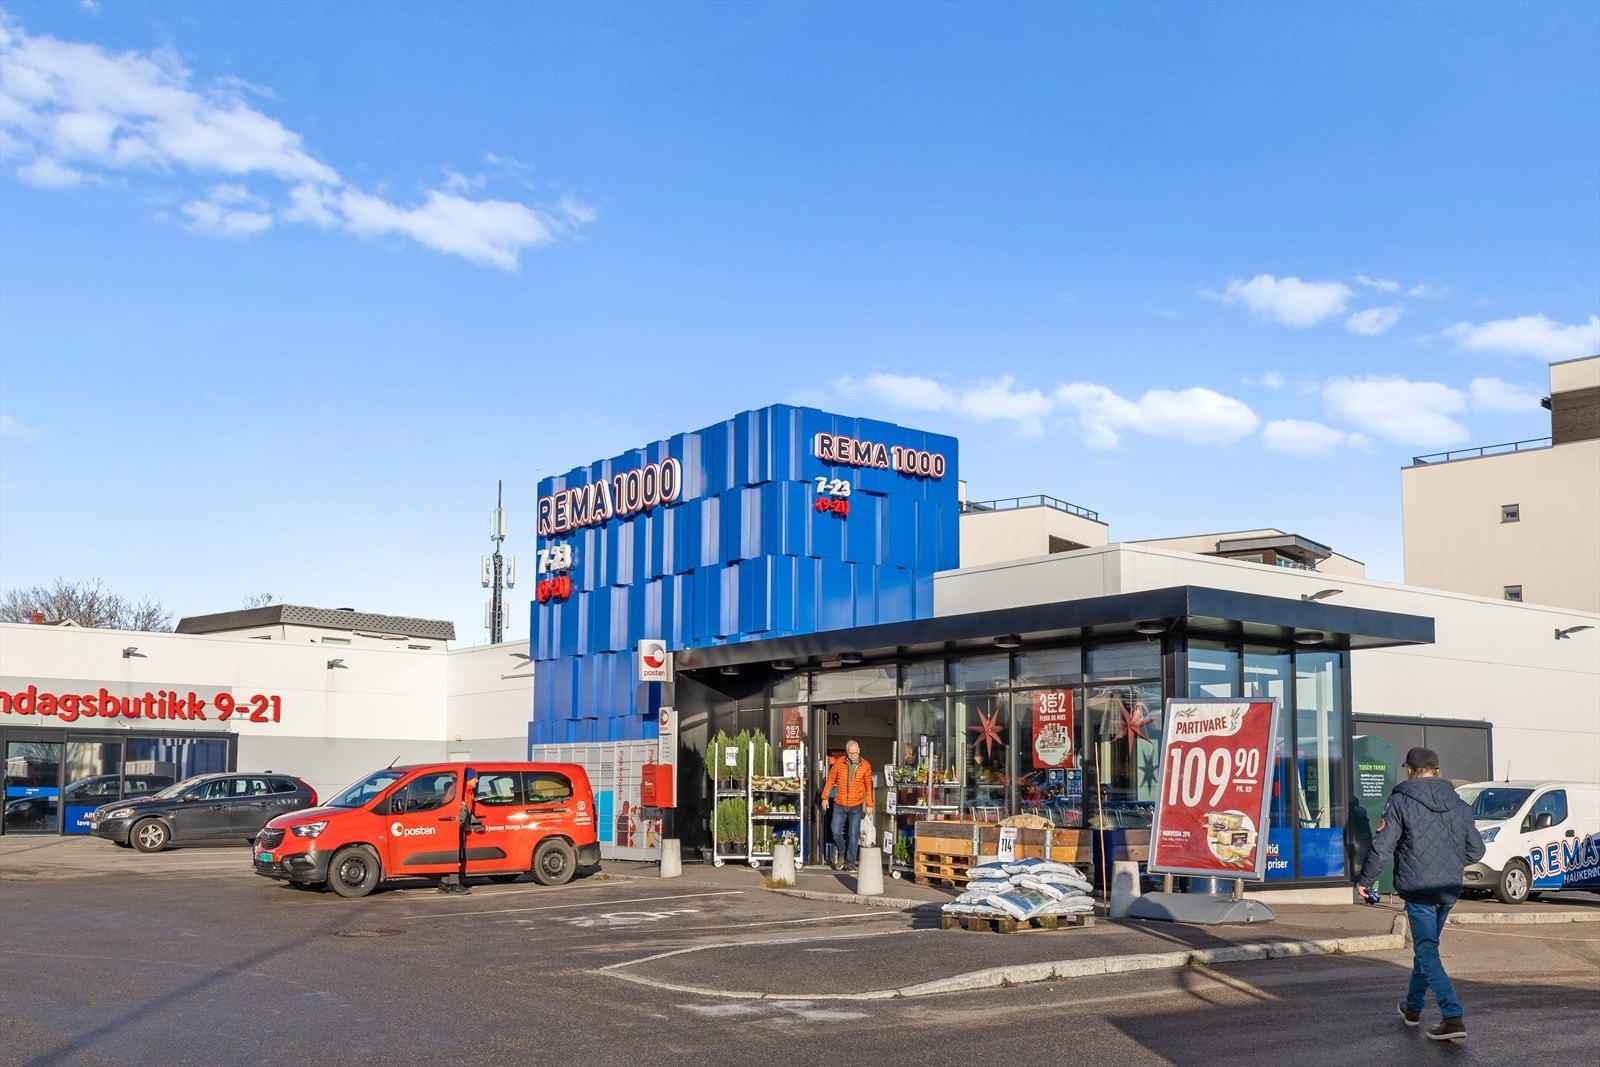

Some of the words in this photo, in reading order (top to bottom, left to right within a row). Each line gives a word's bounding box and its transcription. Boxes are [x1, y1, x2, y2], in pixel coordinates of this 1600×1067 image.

[815, 432, 889, 469] REMA
[891, 445, 945, 478] 1000
[538, 480, 612, 536] REMA
[614, 457, 681, 515] 1000
[815, 477, 851, 497] 7-23
[537, 544, 572, 574] 7-23
[643, 669, 665, 677] posten
[214, 692, 281, 723] 9-21
[1039, 693, 1047, 714] 3
[1047, 693, 1057, 714] FOR
[1058, 692, 1066, 713] 2
[1175, 716, 1227, 734] PARTIVARE
[1169, 747, 1232, 807] 109
[1235, 748, 1260, 778] 90
[404, 826, 436, 838] posten
[1001, 838, 1012, 852] 114
[1266, 844, 1279, 854] ltid
[1267, 859, 1288, 871] priser
[1529, 834, 1599, 881] REMA
